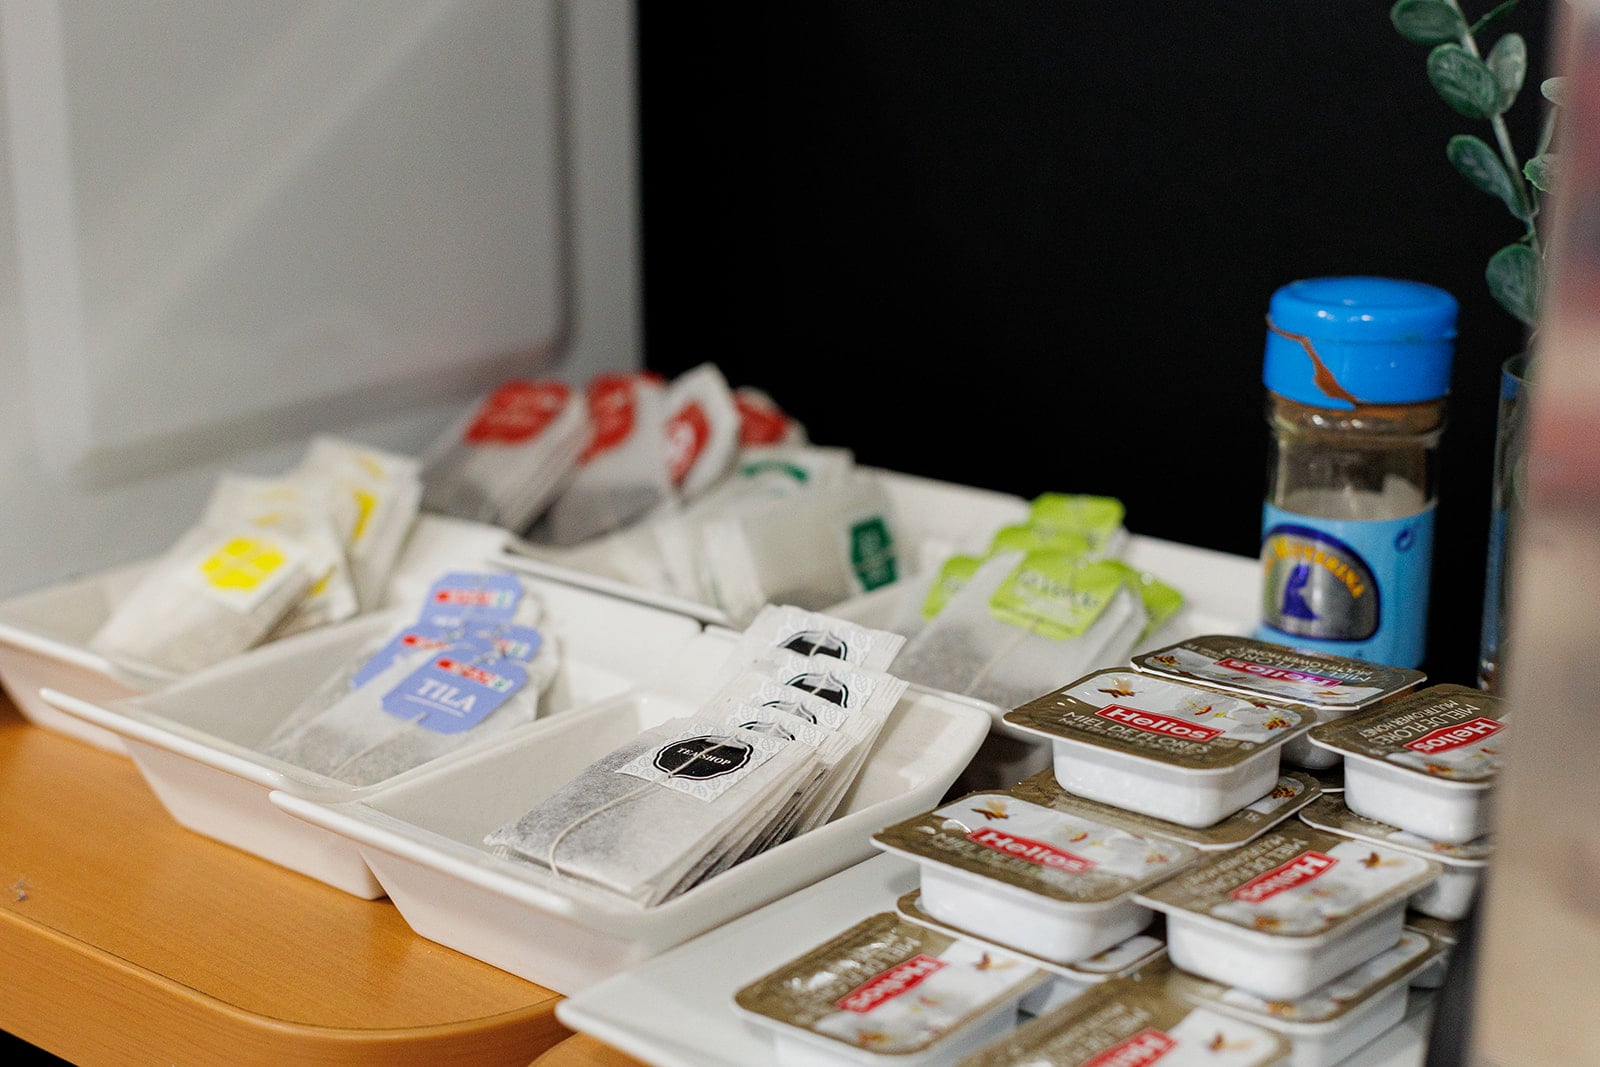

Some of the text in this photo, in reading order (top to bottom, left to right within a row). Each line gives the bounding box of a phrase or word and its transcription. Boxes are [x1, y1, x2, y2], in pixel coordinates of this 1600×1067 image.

[1229, 660, 1333, 687] Helios
[417, 678, 477, 713] TILA
[1063, 711, 1105, 728] MIEL
[1107, 724, 1137, 738] DE
[1106, 708, 1209, 740] Helios
[1358, 699, 1460, 738] MULTIFLOWER HONEY
[1368, 703, 1481, 746] MIEL DE FLORES
[1413, 721, 1498, 751] Helios
[981, 832, 1083, 870] Helios
